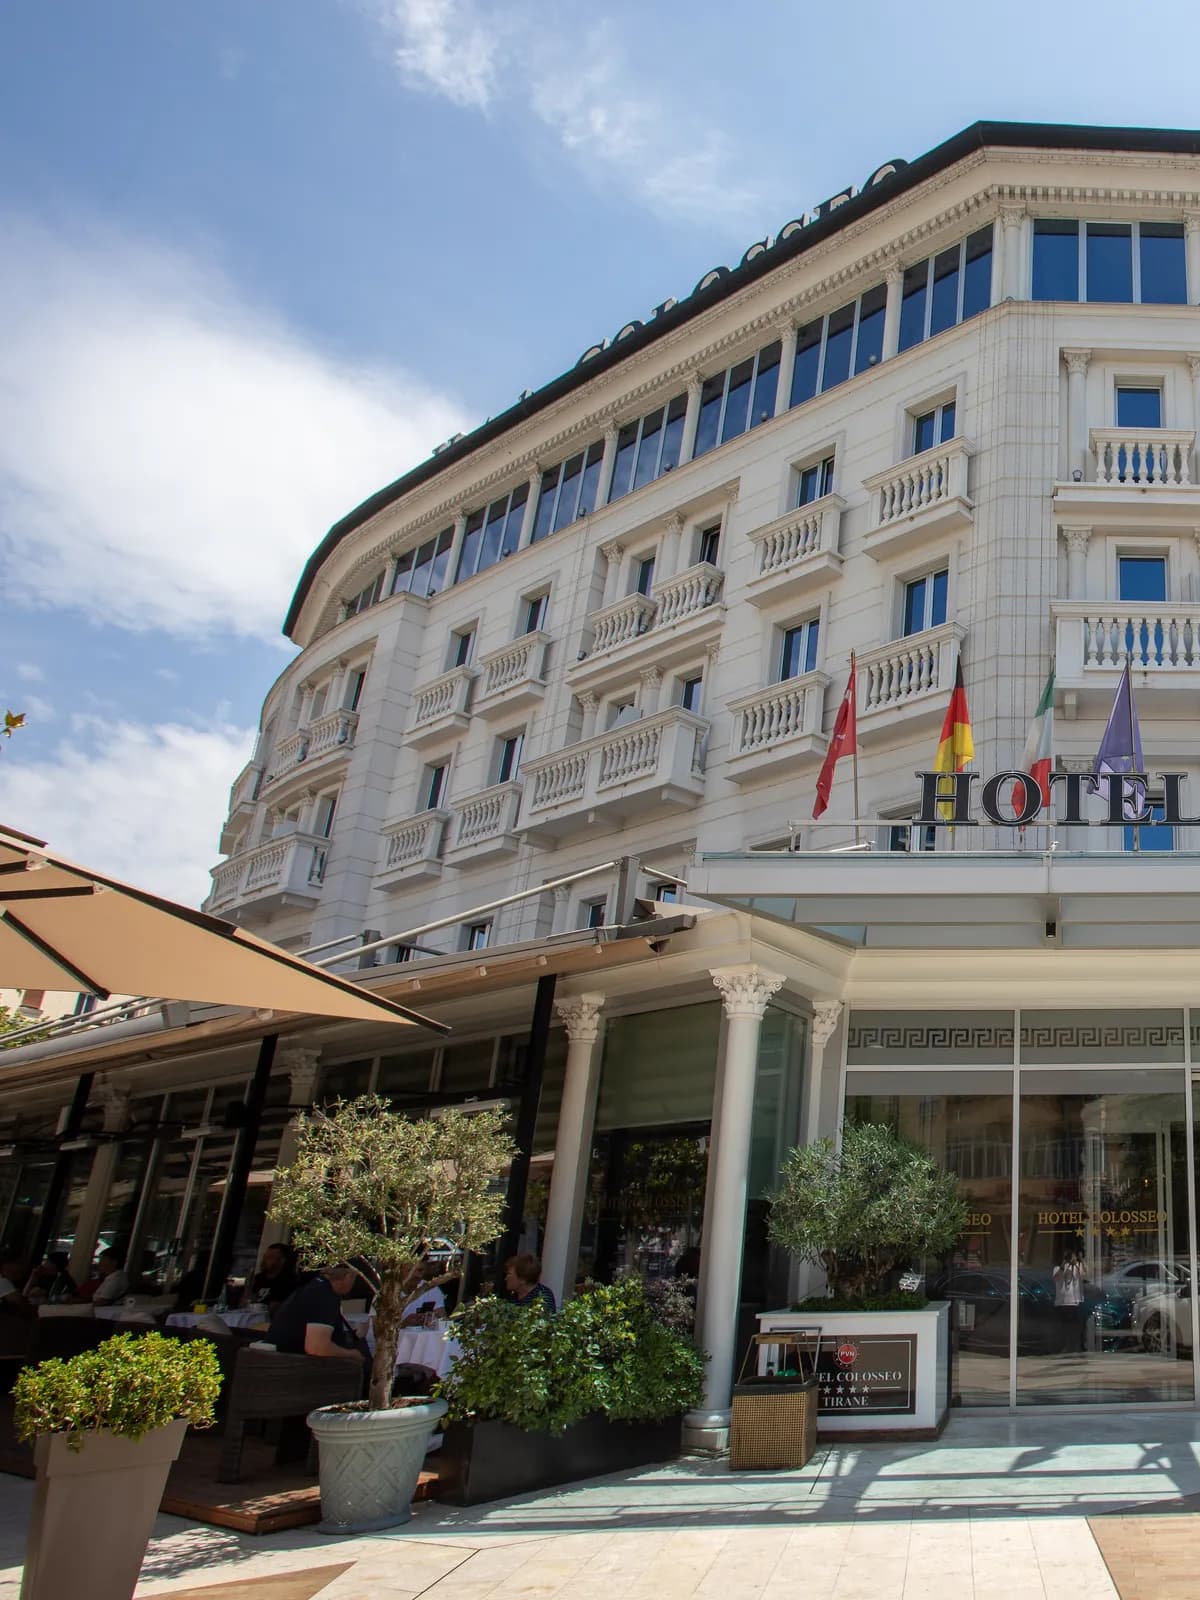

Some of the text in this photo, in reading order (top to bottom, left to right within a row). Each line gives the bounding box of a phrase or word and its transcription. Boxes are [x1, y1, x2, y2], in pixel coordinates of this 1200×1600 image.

[1038, 1209, 1168, 1225] HOTEL COLOSSEO
[836, 1370, 902, 1382] COLOSSEO
[823, 1396, 869, 1407] TIRANE
